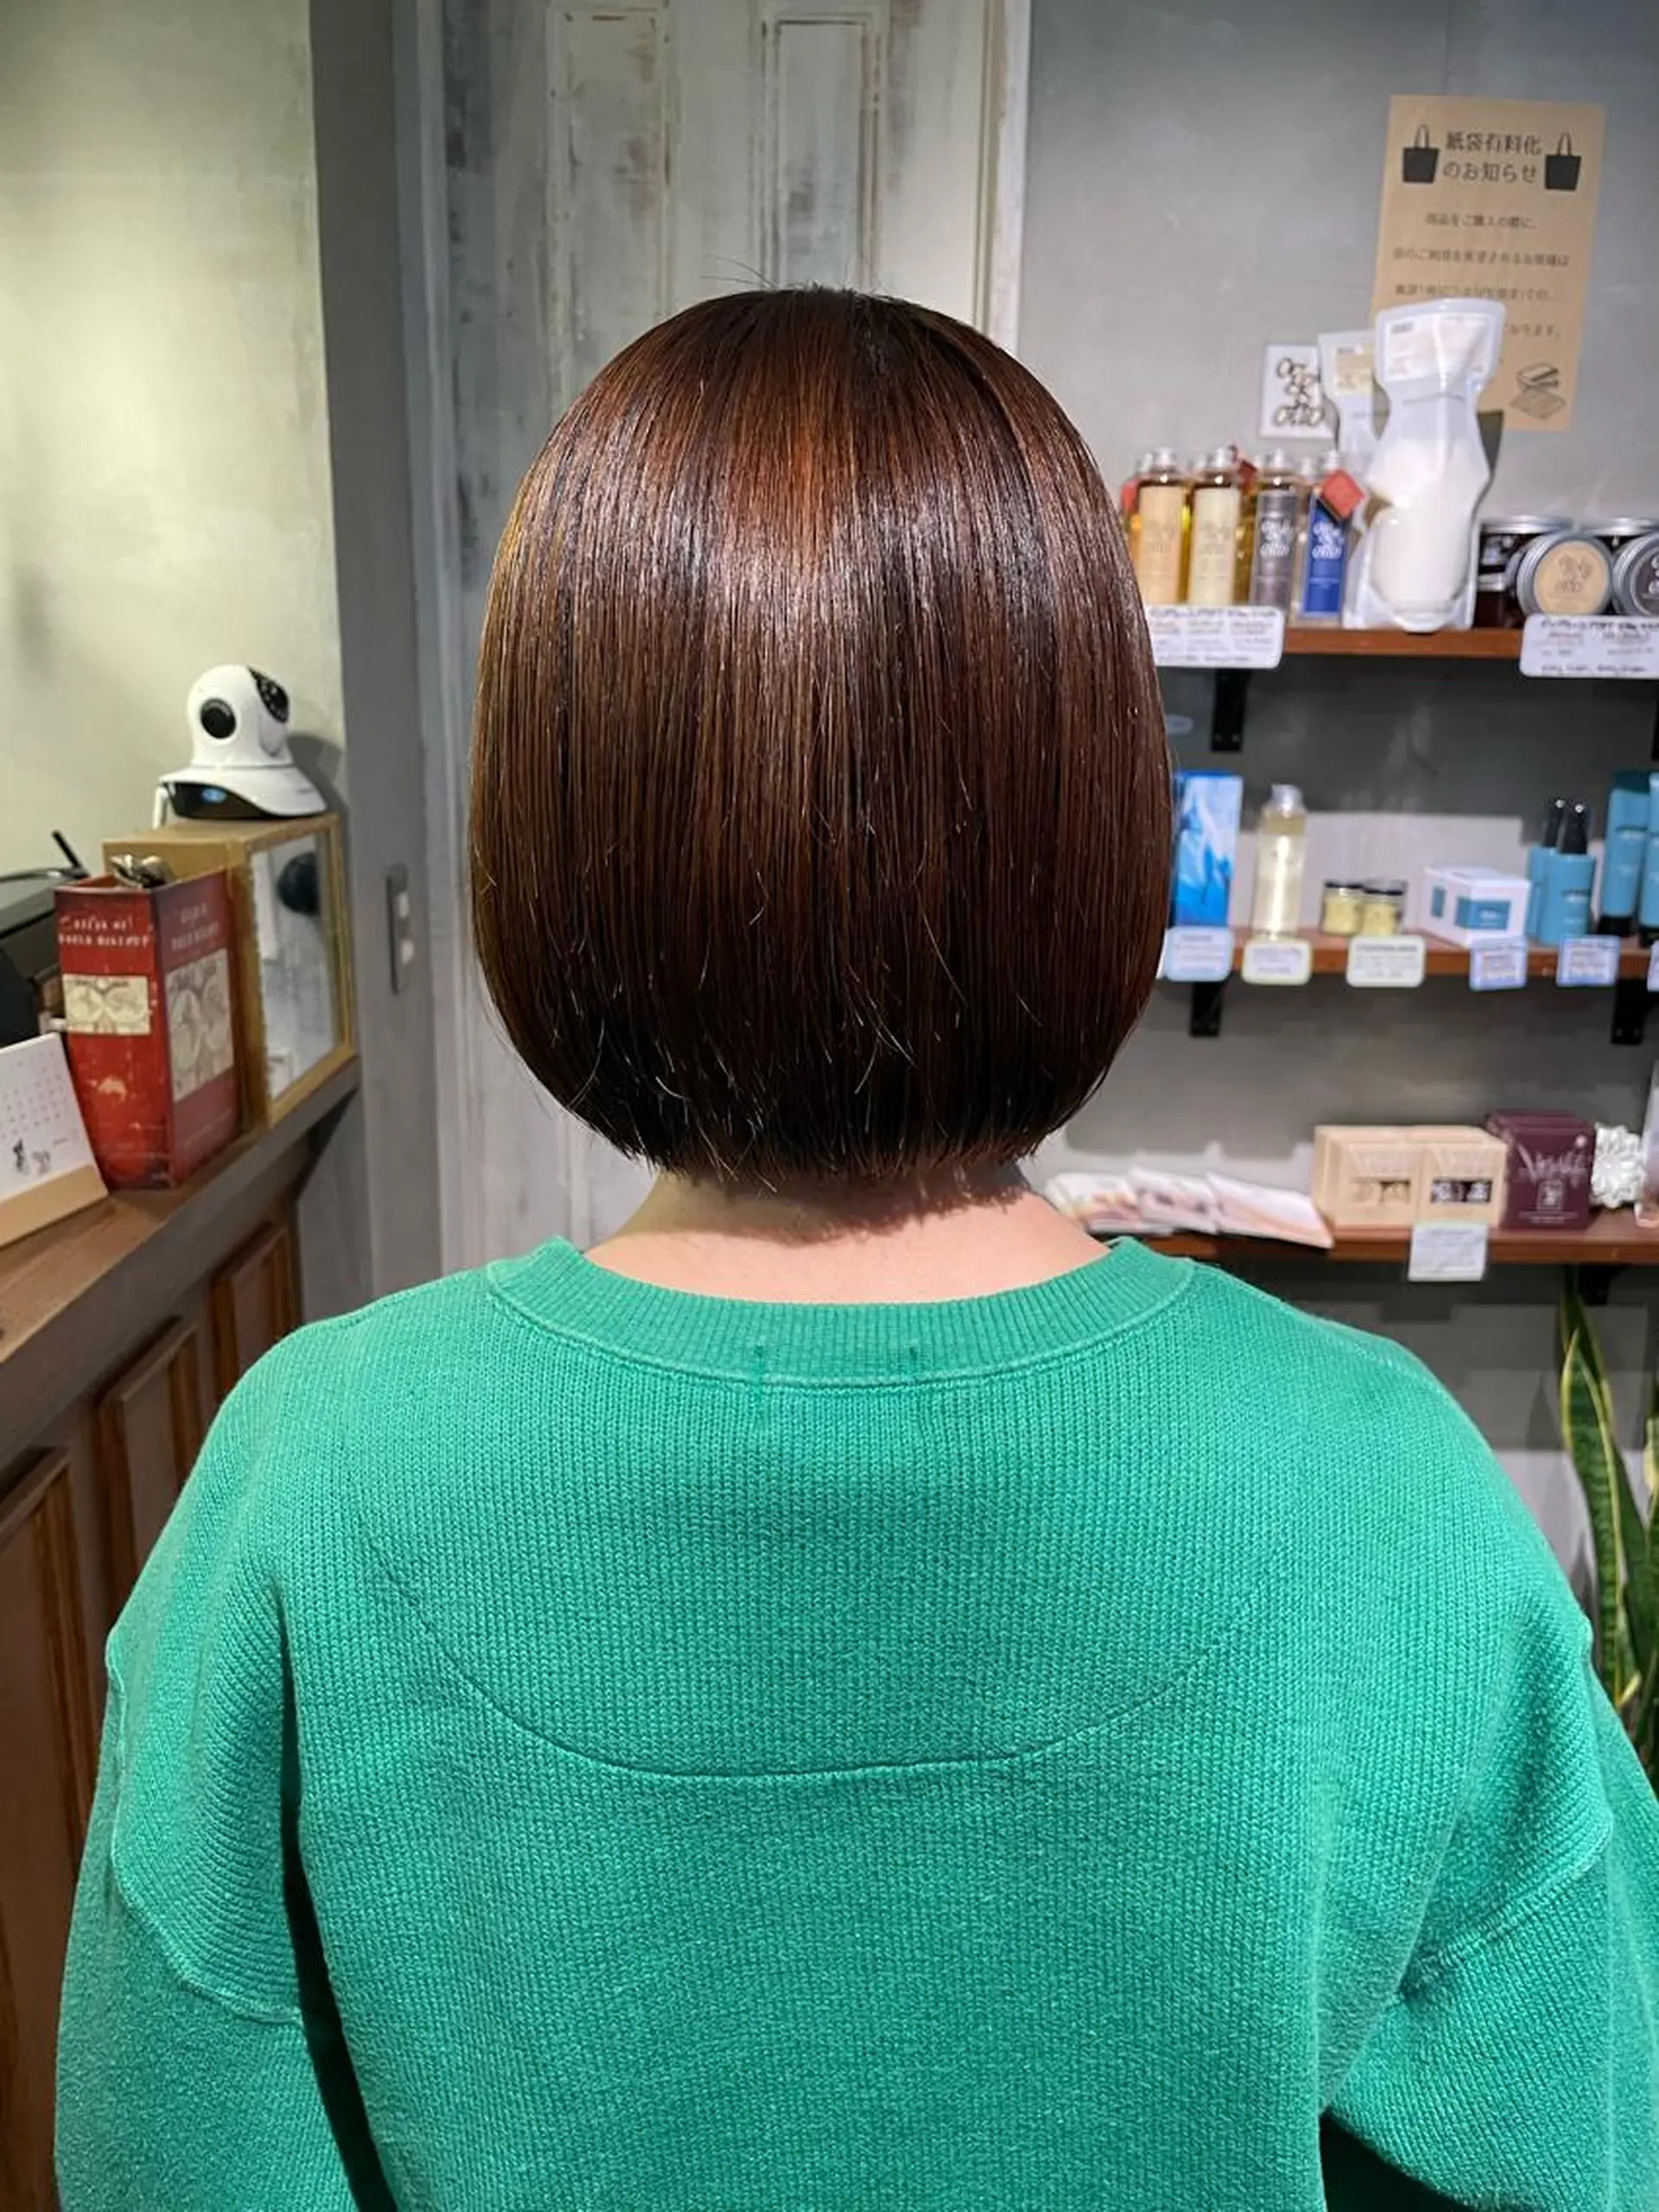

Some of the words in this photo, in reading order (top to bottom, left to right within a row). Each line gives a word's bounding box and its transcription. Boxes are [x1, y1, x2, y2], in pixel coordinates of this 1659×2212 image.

[1446, 130, 1542, 156] 紙袋有料化
[1443, 162, 1536, 183] のお知らせ
